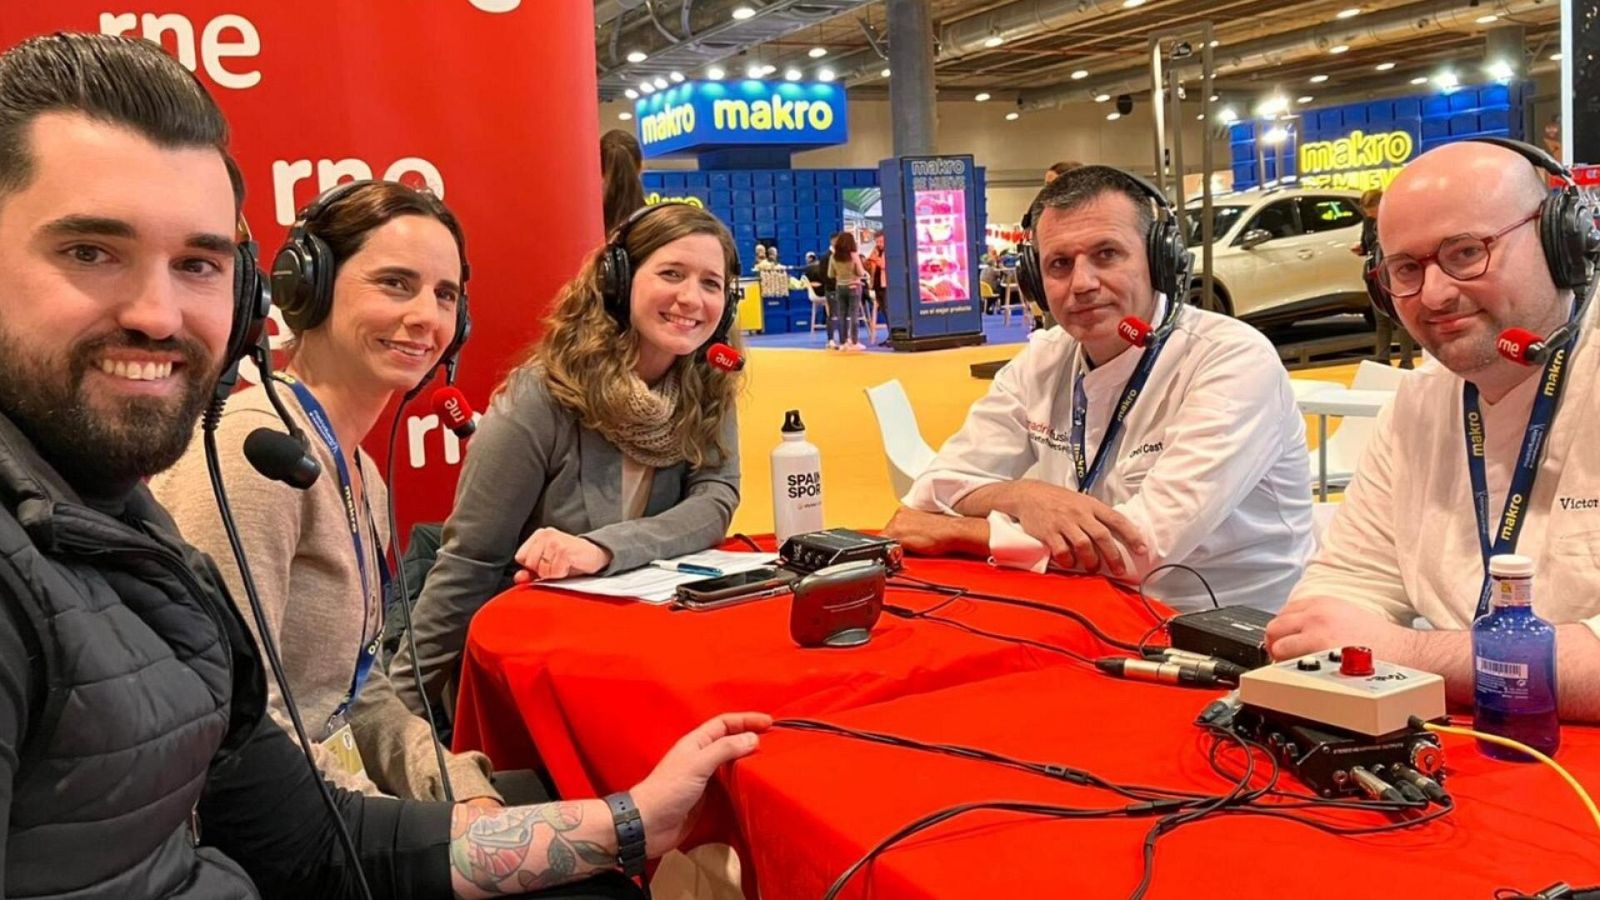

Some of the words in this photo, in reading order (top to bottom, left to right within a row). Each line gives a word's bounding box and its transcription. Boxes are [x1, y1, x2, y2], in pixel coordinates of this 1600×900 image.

[641, 102, 695, 145] makro
[714, 94, 833, 130] makro
[1300, 129, 1412, 173] makro
[911, 158, 966, 175] makro
[1120, 321, 1139, 340] rne
[715, 352, 734, 367] rne
[1498, 338, 1520, 358] rne
[444, 397, 465, 423] rne
[1117, 389, 1137, 422] makro
[1468, 411, 1484, 457] makro
[1501, 493, 1522, 541] makro
[1560, 497, 1598, 510] Victor
